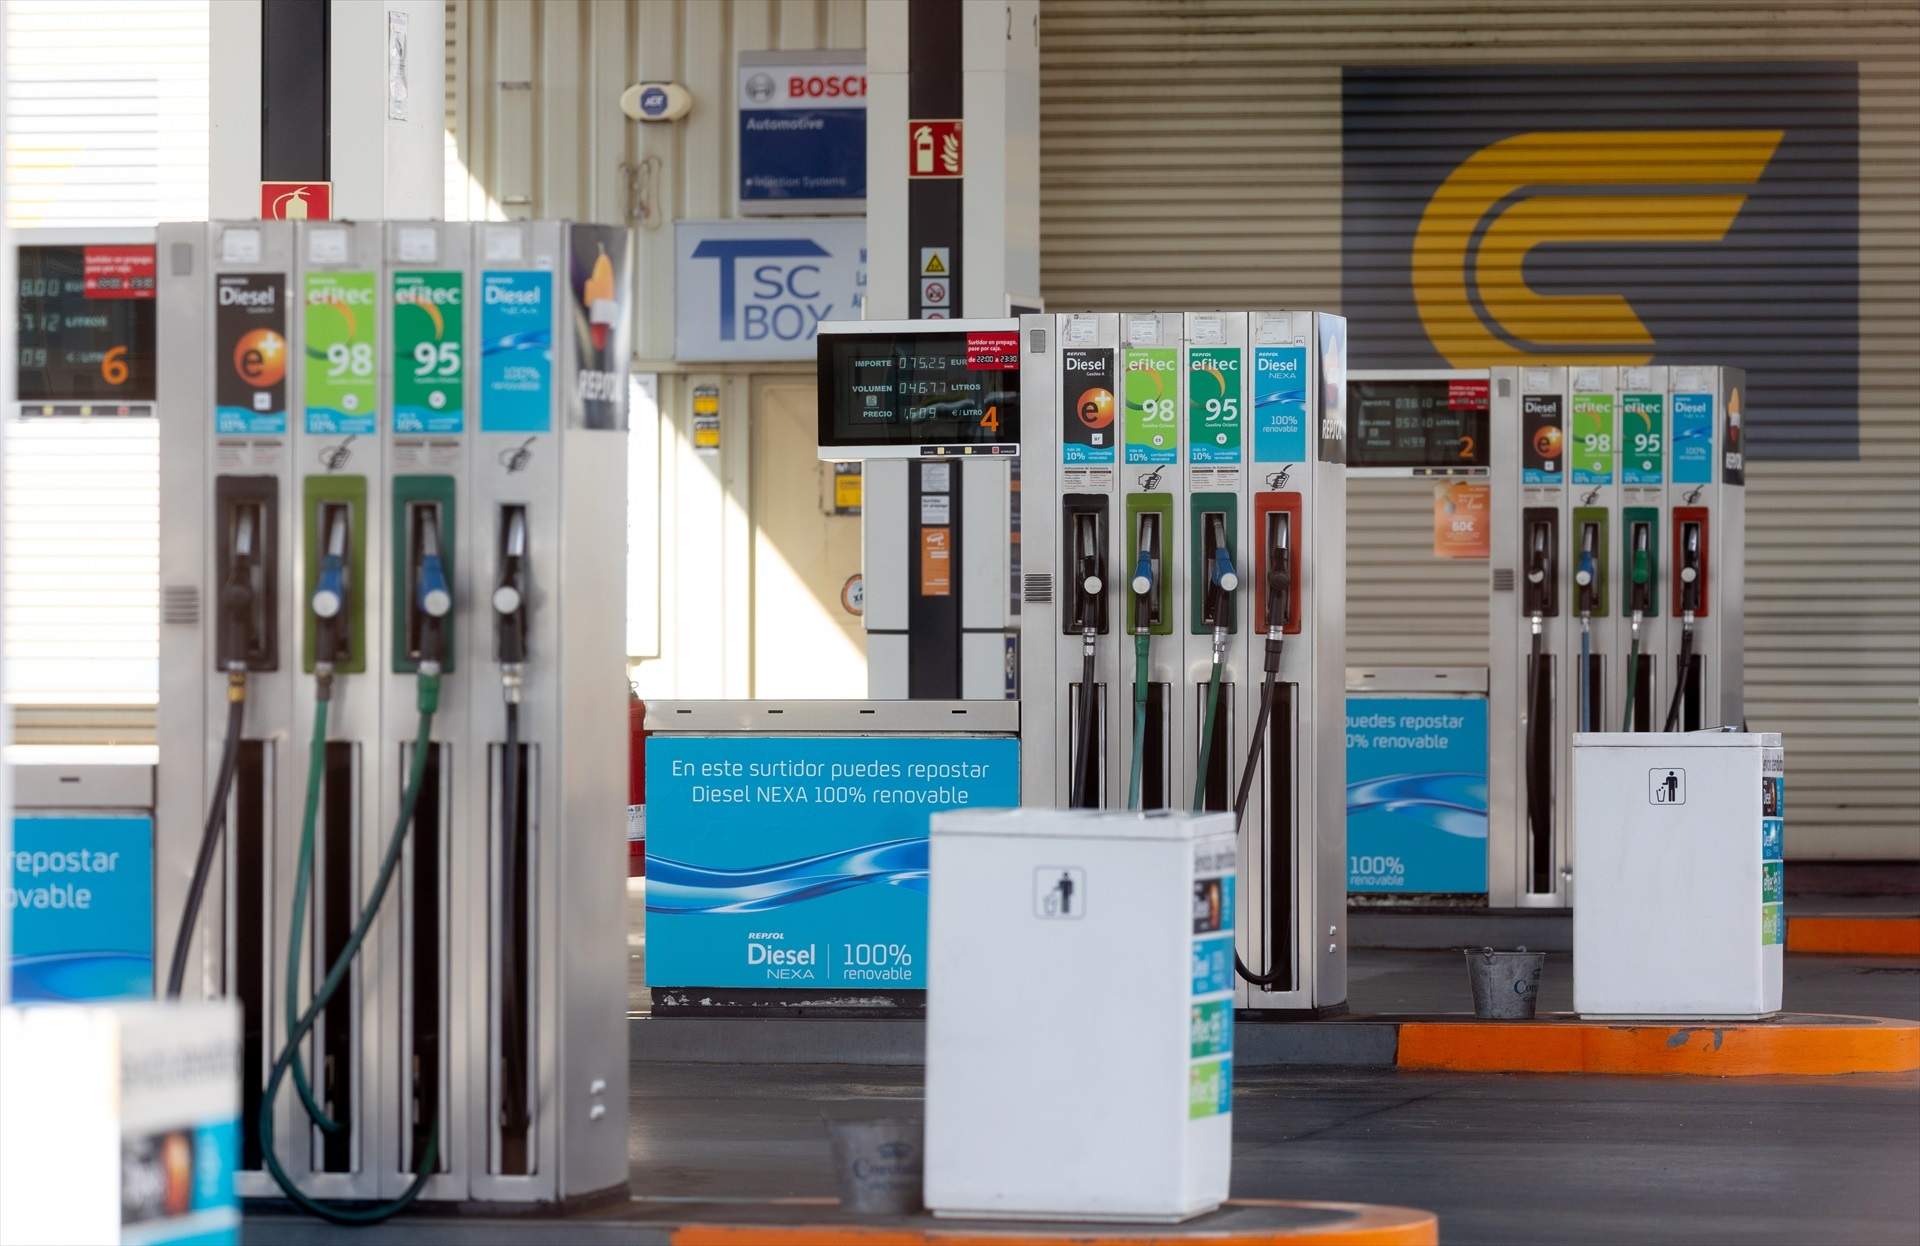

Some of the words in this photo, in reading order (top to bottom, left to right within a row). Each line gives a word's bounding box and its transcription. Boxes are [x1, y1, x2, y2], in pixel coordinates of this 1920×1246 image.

[746, 118, 825, 130] Automotive
[220, 287, 275, 306] Diesel
[396, 286, 460, 304] efitec
[485, 285, 541, 304] Diesel
[744, 304, 833, 341] BOX
[101, 345, 128, 385] 6
[327, 343, 373, 376] 98
[414, 342, 460, 375] 95
[1067, 358, 1105, 371] Diesel
[1129, 359, 1175, 371] efitec
[1192, 358, 1237, 370] efitec
[1258, 358, 1297, 370] Diesel
[1142, 399, 1174, 421] 98
[1205, 399, 1237, 420] 95
[1525, 402, 1556, 413] Diesel
[1675, 402, 1706, 413] Diesel
[980, 406, 999, 432] 4
[1272, 416, 1297, 424] 100%
[1458, 436, 1474, 458] 2
[1585, 434, 1610, 452] 98
[1635, 434, 1660, 452] 95
[1067, 452, 1086, 460] 10%
[1129, 453, 1149, 461] 10%
[1193, 452, 1212, 460] 10%
[1400, 714, 1464, 730] repostar
[1373, 734, 1448, 749] renovable
[672, 760, 695, 778] En
[701, 760, 742, 778] este
[749, 759, 825, 778] surtidor
[831, 759, 901, 781] puedes
[907, 761, 990, 782] repostar
[692, 785, 750, 803] Diesel
[757, 786, 808, 804] NEXA
[815, 786, 866, 804] 100%
[873, 786, 968, 804] renovable
[1350, 856, 1404, 874] 100%
[1350, 875, 1404, 886] renovable
[748, 932, 785, 940] REPSOL
[748, 943, 815, 966] Diesel
[843, 944, 912, 966] 100%
[767, 969, 815, 979] NEXA
[843, 967, 912, 981] renovable
